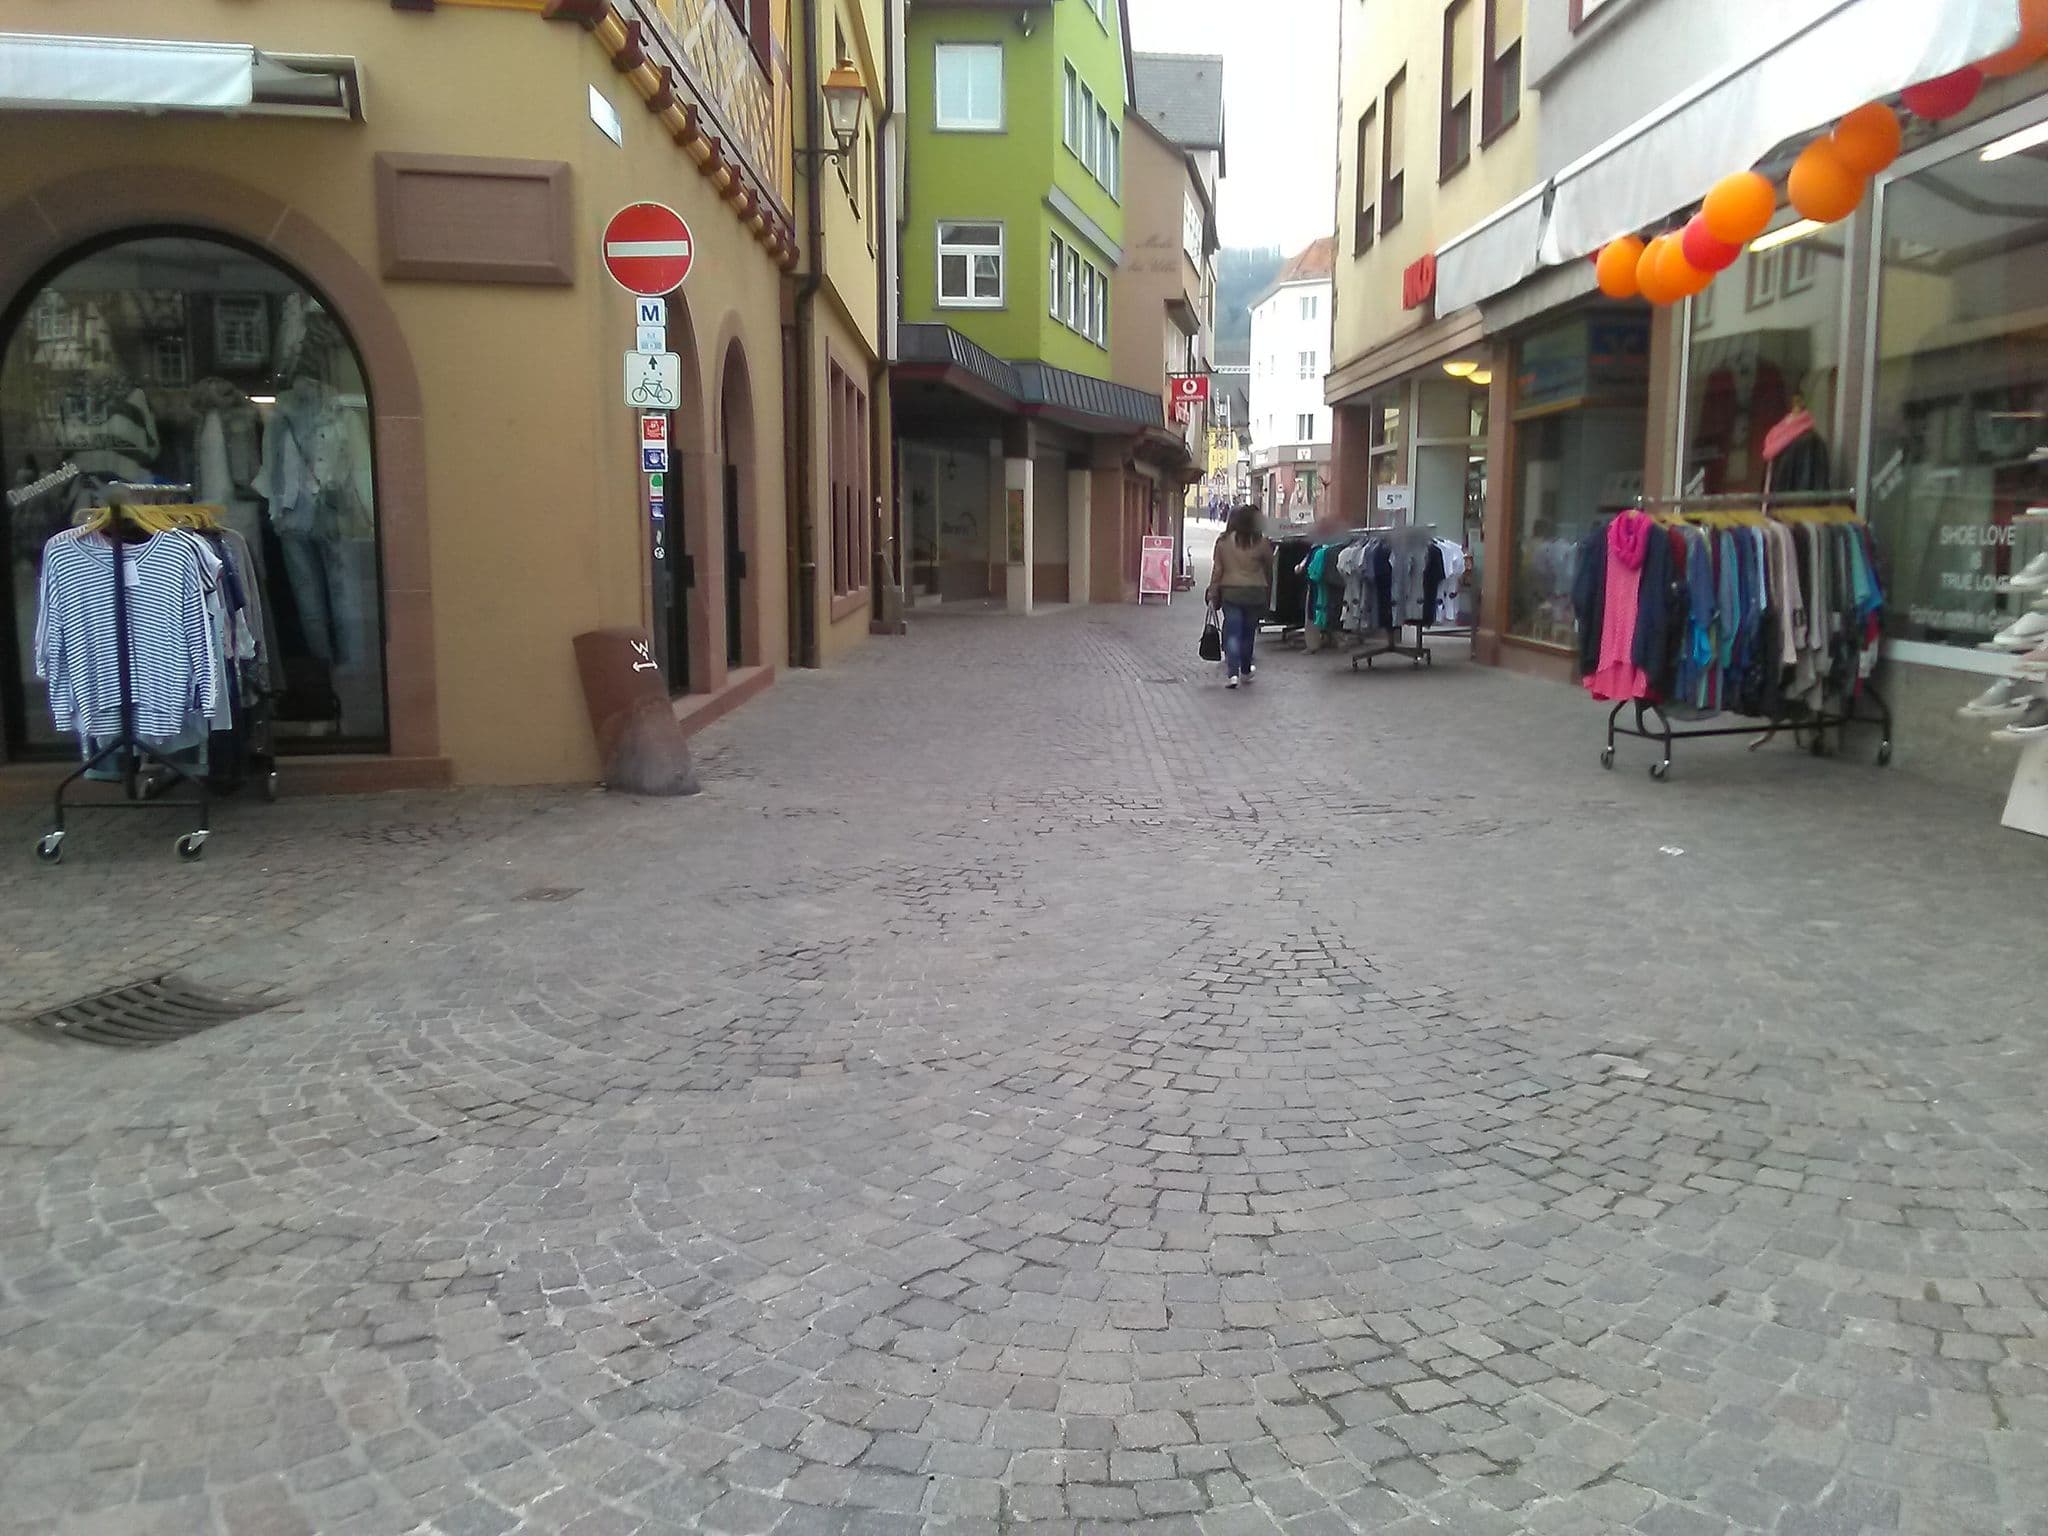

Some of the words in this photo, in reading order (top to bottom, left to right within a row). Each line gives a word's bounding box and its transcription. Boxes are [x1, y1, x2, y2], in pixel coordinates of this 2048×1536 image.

[641, 305, 659, 322] M
[6, 461, 80, 506] Damenmode
[1940, 525, 1977, 545] SHOE
[1980, 525, 2016, 545] LOVE
